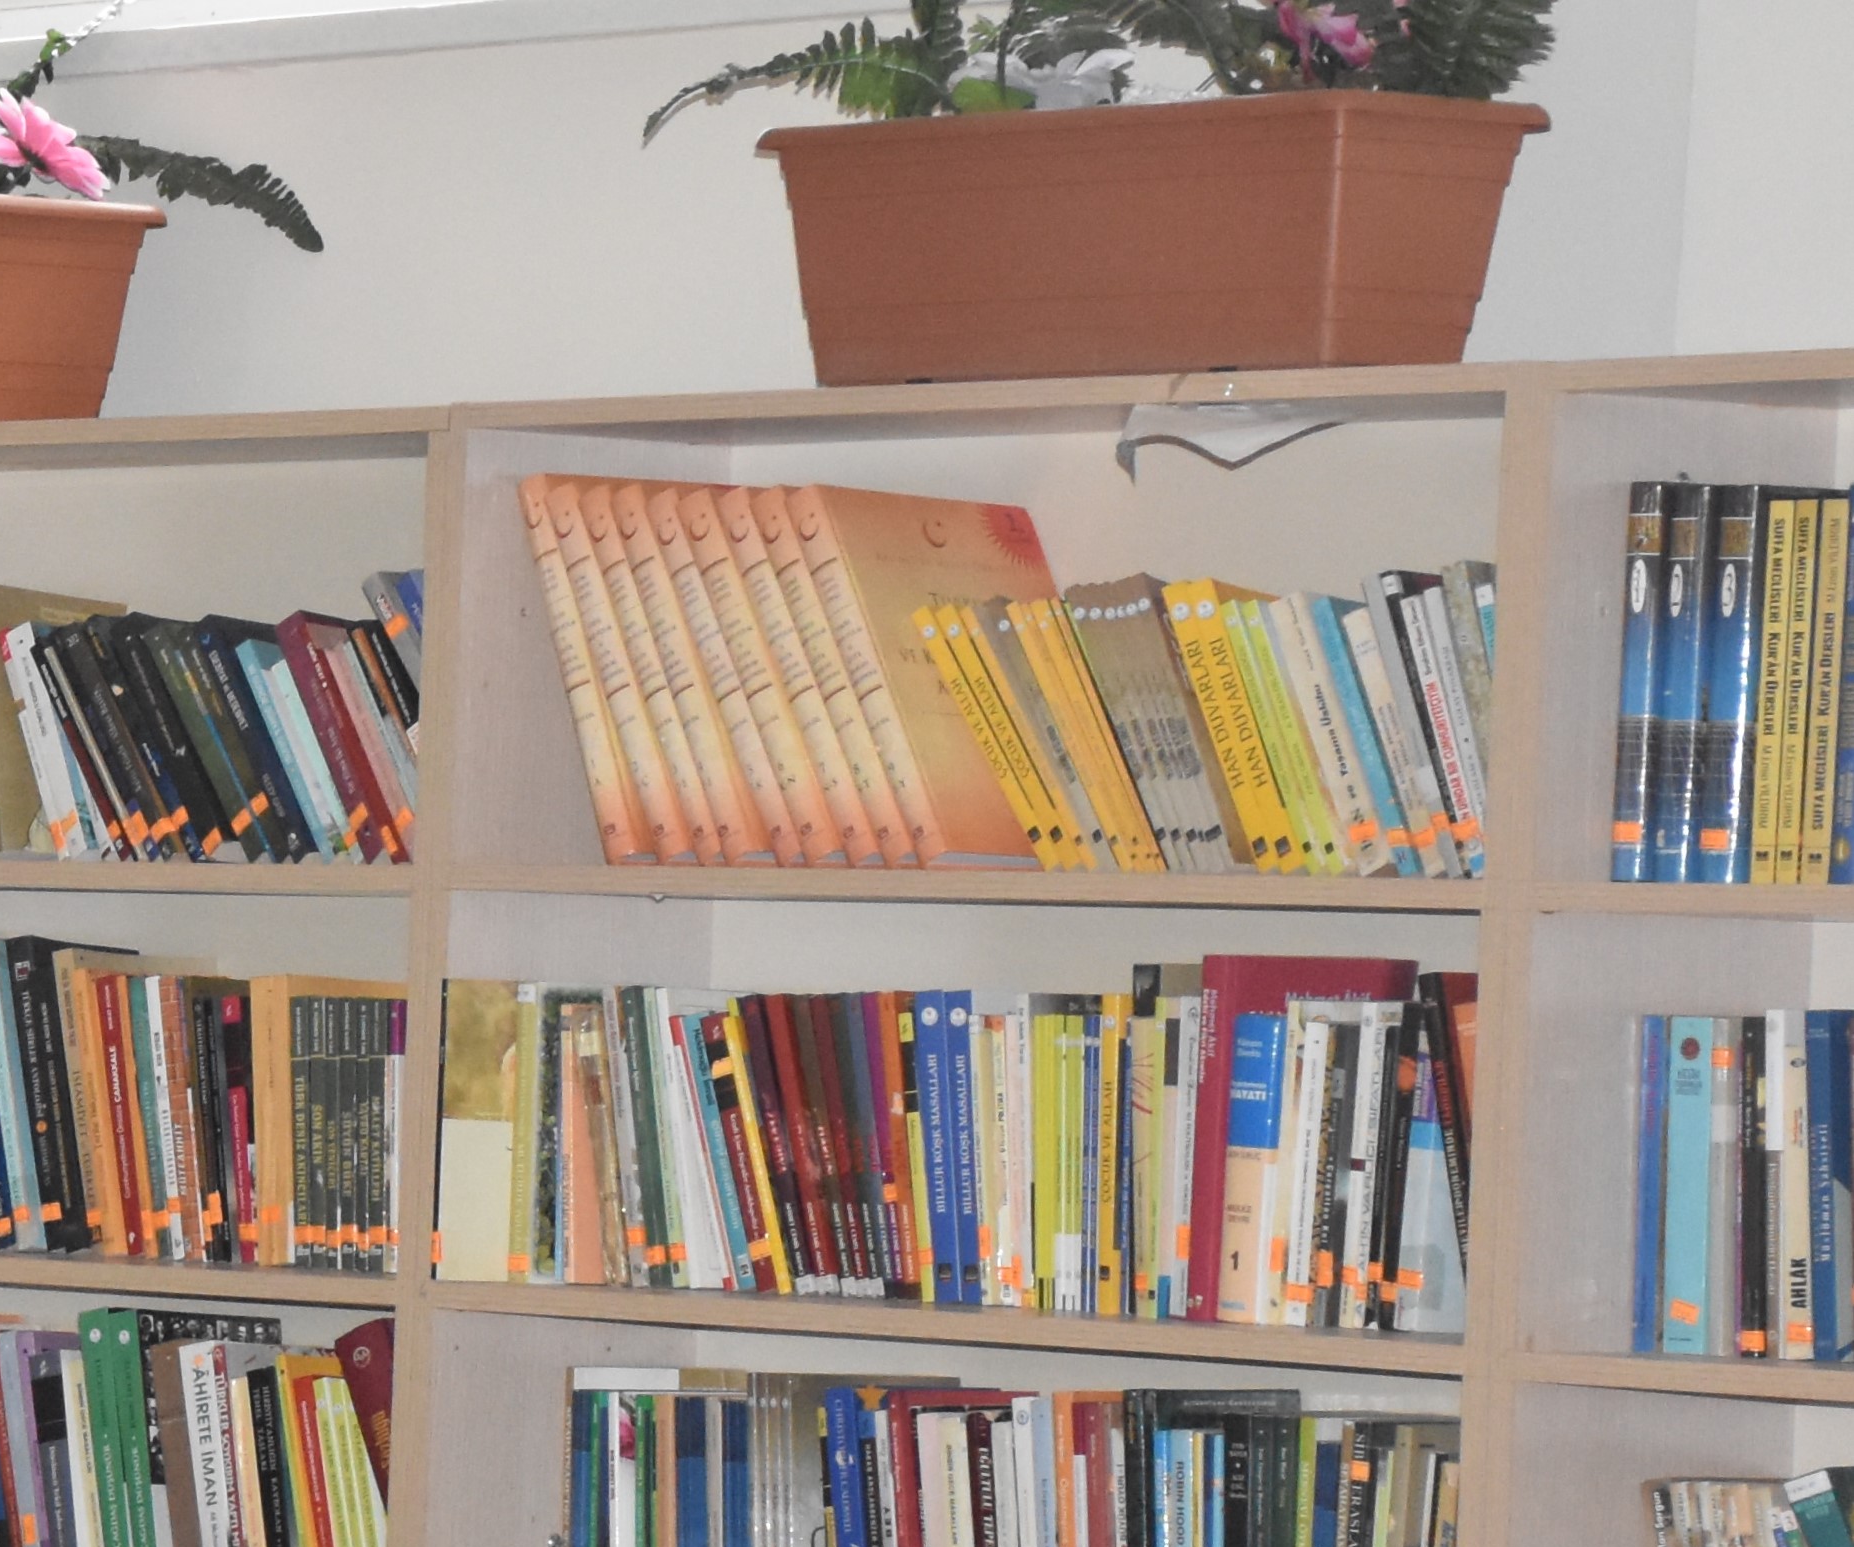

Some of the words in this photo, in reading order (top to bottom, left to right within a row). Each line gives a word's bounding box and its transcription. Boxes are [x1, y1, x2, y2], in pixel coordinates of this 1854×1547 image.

[1772, 518, 1786, 554] SUFFA
[1797, 516, 1810, 552] SUFFA
[1768, 557, 1784, 623] MECLİSLERİ
[1793, 555, 1808, 621] MECLİSLERİ
[948, 677, 975, 716] ALLAH
[973, 676, 999, 716] ALLAH
[1184, 638, 1230, 742] DUVARLARI
[1210, 636, 1254, 741] DUVARLARI
[970, 718, 984, 734] VE
[994, 719, 1008, 734] VE
[979, 736, 1009, 779] ÇOCUK
[1219, 746, 1245, 788] HAN
[1244, 745, 1268, 787] HAN
[1814, 725, 1828, 790] MECLİSLERİ
[1811, 794, 1824, 829] SUFFA
[107, 1045, 122, 1103] ÇANAKKALE
[293, 1076, 305, 1109] TÜRK
[927, 1053, 941, 1125] MASALLARI
[955, 1054, 968, 1125] MASALLARI
[311, 1104, 322, 1128] SON
[1102, 1081, 1112, 1125] ALLAH
[294, 1112, 306, 1149] DENİZ
[312, 1133, 323, 1163] AKIN
[325, 1120, 335, 1137] SON
[930, 1128, 944, 1162] KÖŞK
[1101, 1131, 1111, 1148] VE
[296, 1153, 309, 1224] AKINCILARI
[933, 1165, 946, 1212] BİLLUR
[960, 1167, 972, 1213] BİLLUR
[1100, 1157, 1111, 1203] ÇOCUK
[1231, 1251, 1239, 1270] 1
[1790, 1258, 1806, 1308] AHLAK
[251, 1388, 262, 1419] TEMEL
[214, 1372, 230, 1428] TÜRKLER
[227, 1495, 240, 1529] YAPTI
[256, 1426, 268, 1471] TAŞLARI
[103, 1444, 117, 1500] DÜŞÜNÜR
[131, 1447, 144, 1503] DÜŞÜNÜR
[200, 1450, 220, 1506] İMAN
[947, 1473, 955, 1495] GECE
[977, 1447, 992, 1509] UĞULTULU
[1175, 1461, 1184, 1502] ROBIN
[880, 1506, 893, 1537] BEY
[949, 1498, 959, 1544] MASALLARI
[1175, 1506, 1184, 1546] HOOD
